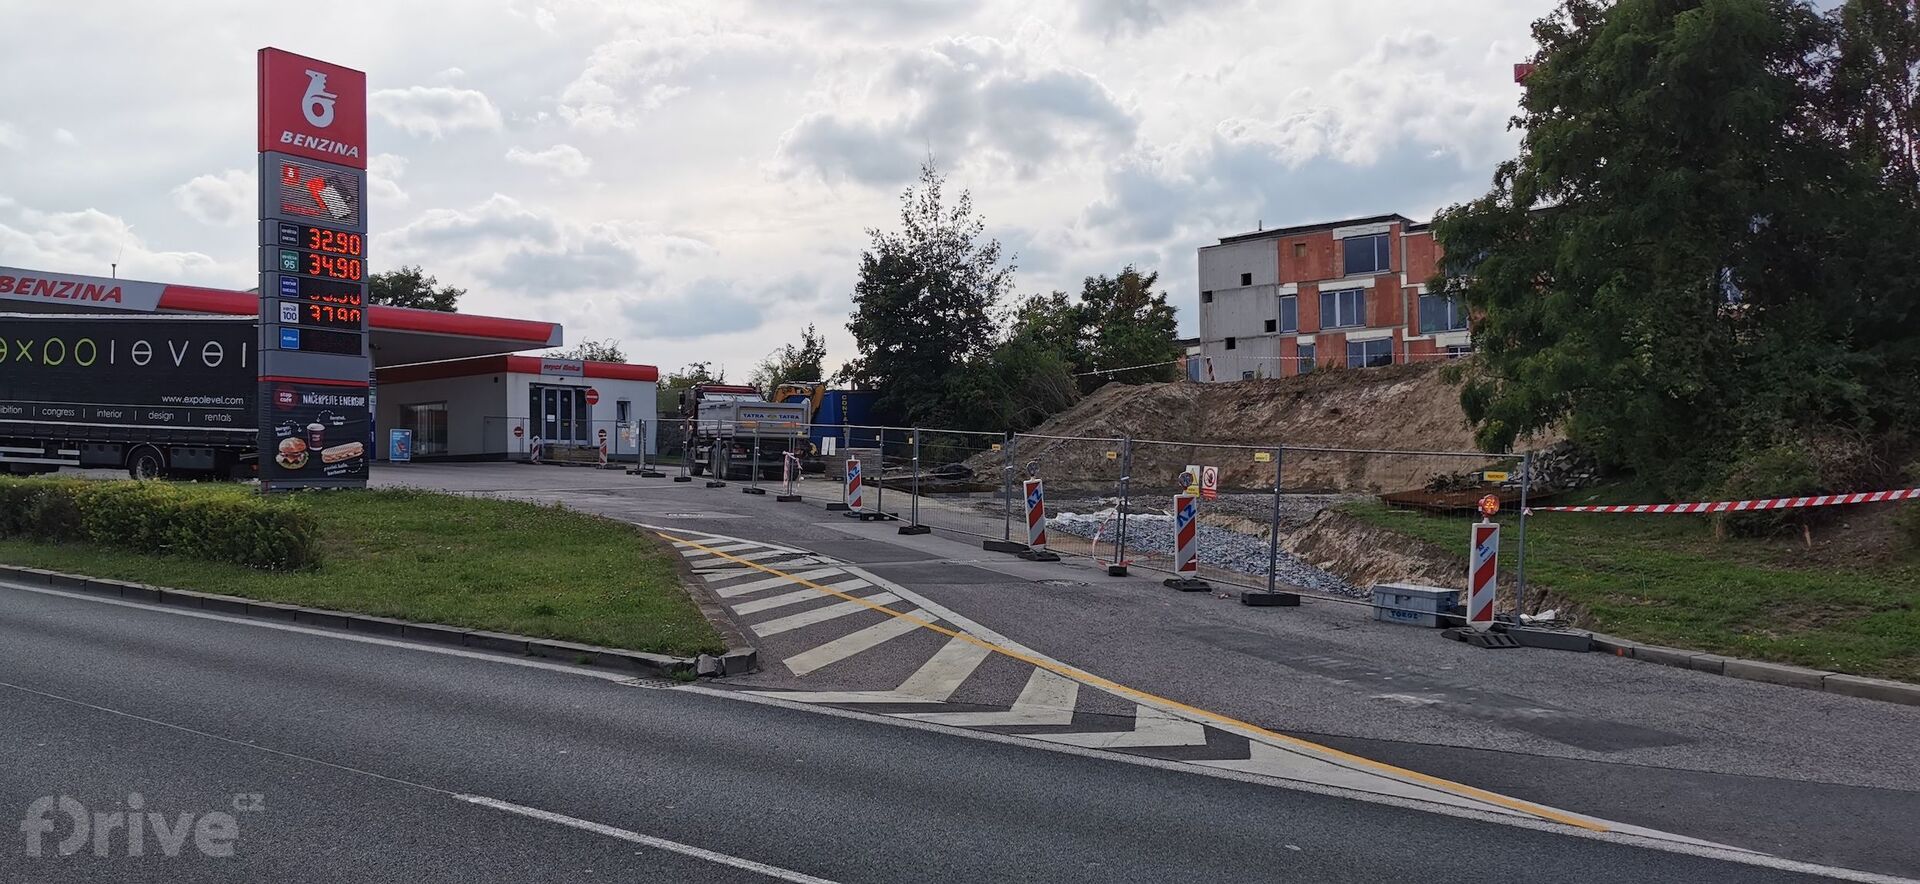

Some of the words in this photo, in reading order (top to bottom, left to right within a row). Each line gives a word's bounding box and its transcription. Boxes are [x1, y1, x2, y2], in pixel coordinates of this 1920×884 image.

[280, 131, 359, 158] BENZINA
[309, 227, 361, 255] 32.90
[284, 259, 295, 269] 95
[309, 253, 361, 280] 34.90
[0, 275, 122, 303] BENZINA
[282, 311, 297, 321] 100
[161, 394, 244, 406] www.expolevel.com
[42, 407, 75, 417] congress
[97, 408, 122, 418] interior
[148, 410, 175, 422] design
[204, 412, 232, 422] rentals
[1177, 504, 1196, 527] AZ
